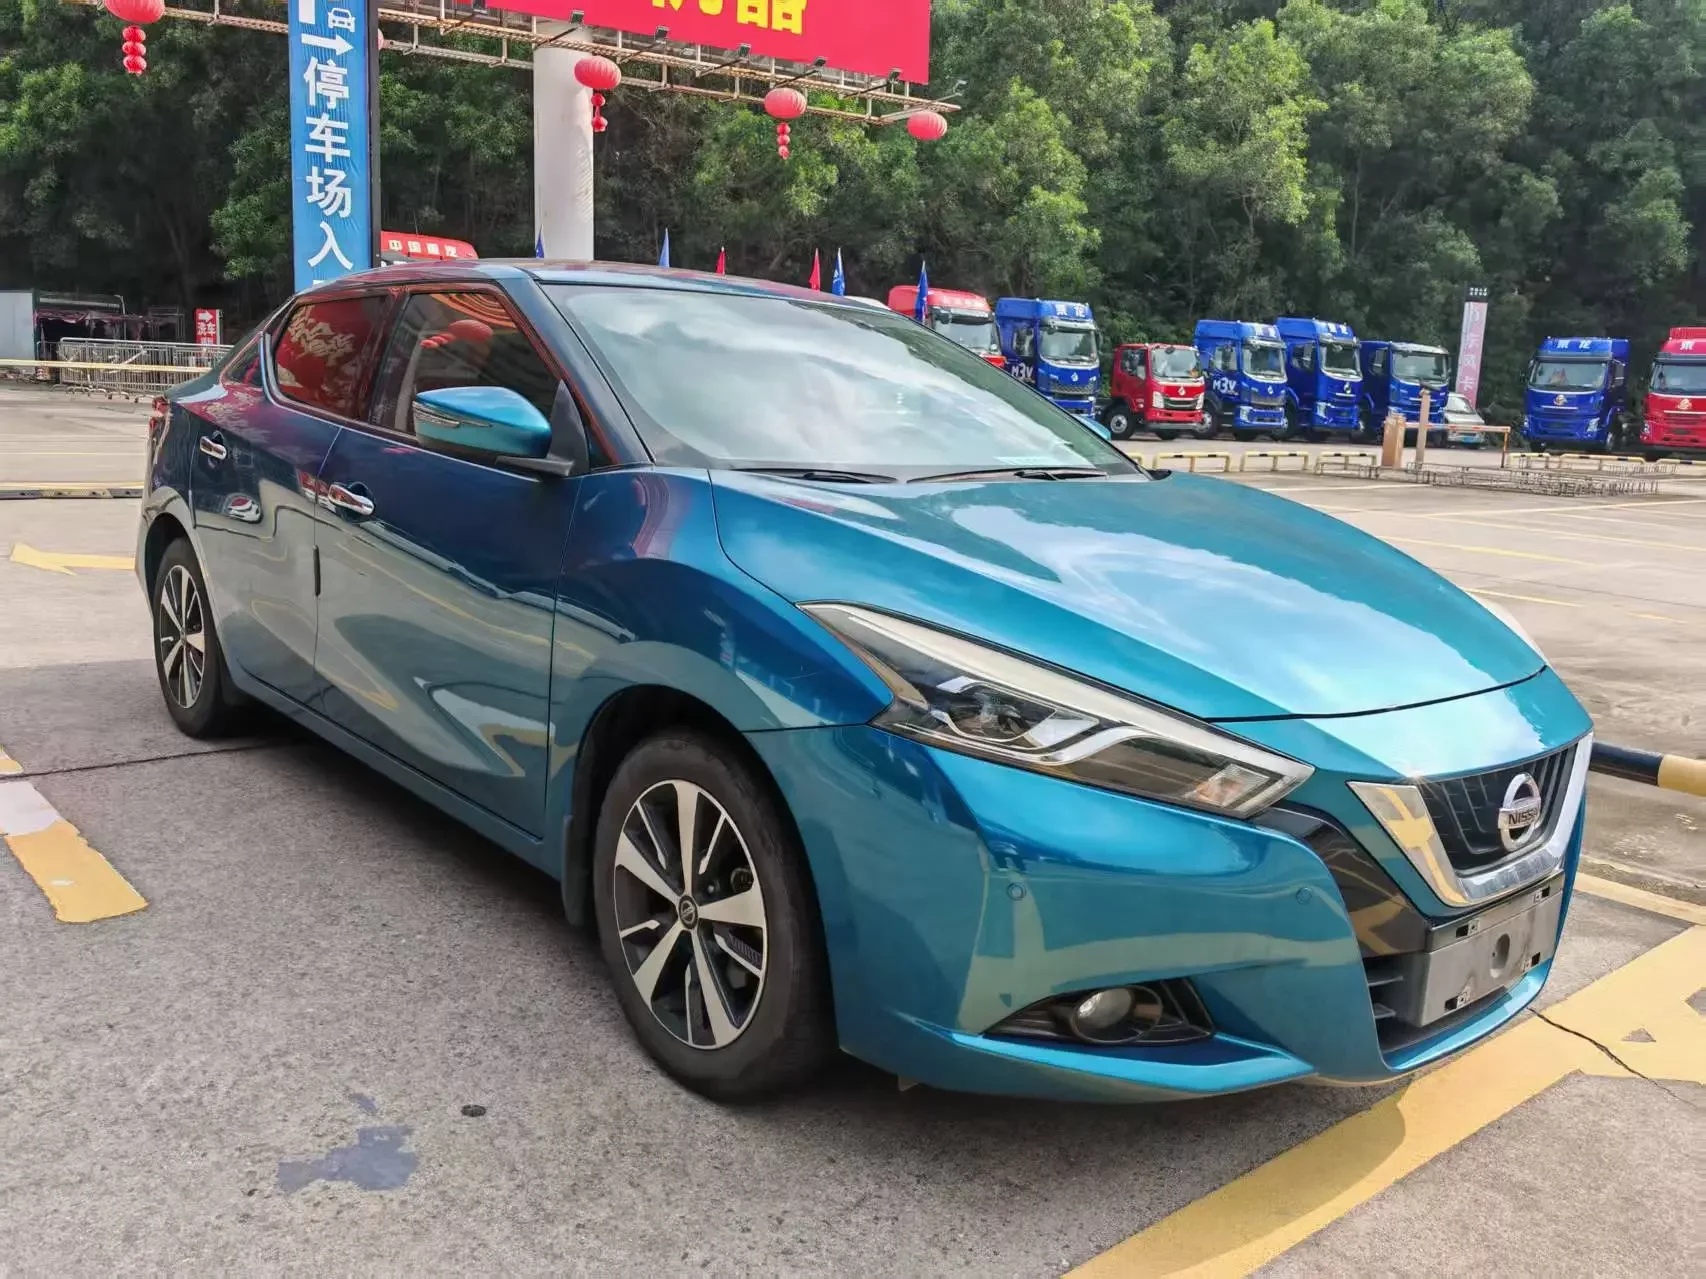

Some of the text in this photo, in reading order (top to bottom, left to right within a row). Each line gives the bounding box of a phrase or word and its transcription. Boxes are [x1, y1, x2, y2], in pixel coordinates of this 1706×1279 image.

[303, 55, 354, 284] 停车场入
[1212, 376, 1238, 394] M3V
[1508, 806, 1540, 825] NISSA
